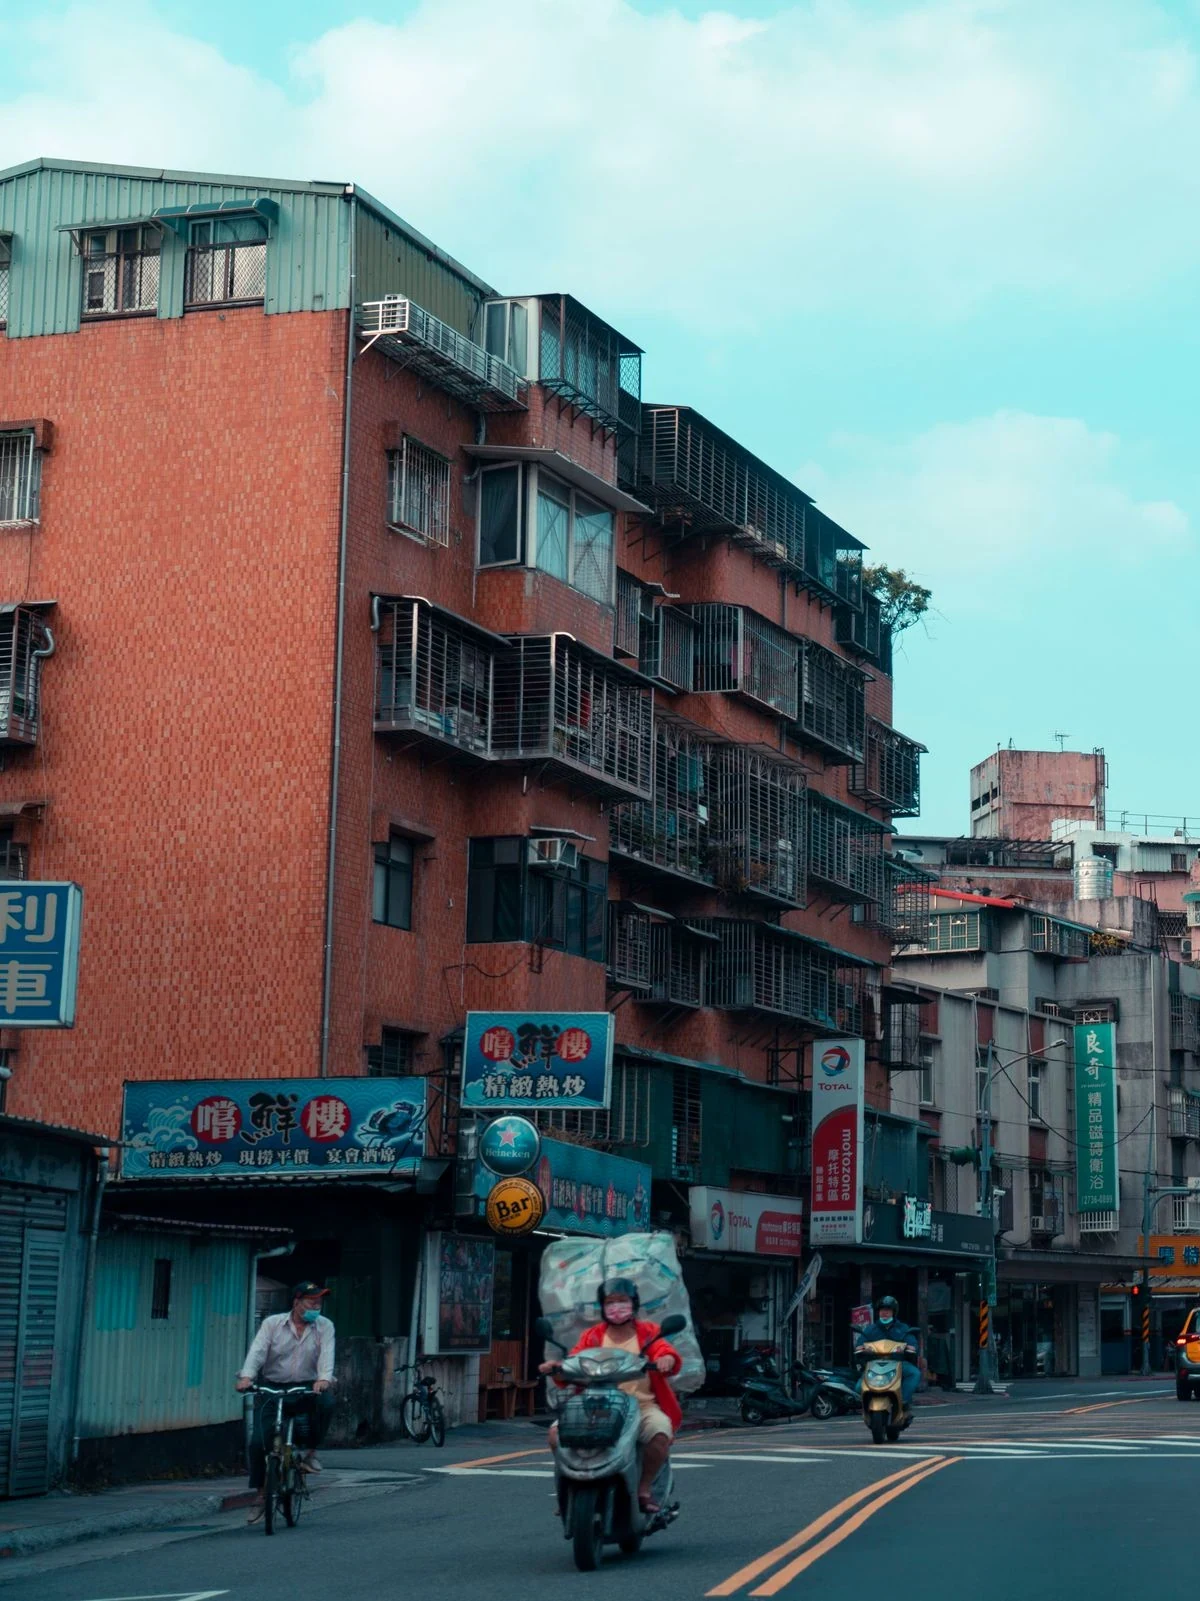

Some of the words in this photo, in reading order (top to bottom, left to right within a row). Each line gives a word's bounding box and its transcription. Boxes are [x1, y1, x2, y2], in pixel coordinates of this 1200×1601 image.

[483, 1023, 589, 1070] 嚐鮮樓
[1084, 1030, 1104, 1080] 良奇
[484, 1075, 586, 1097] 精緻熱炒
[818, 1083, 853, 1091] TOTAL
[196, 1092, 346, 1145] 嚐鮮樓
[150, 1151, 222, 1168] 精緻熱炒
[239, 1149, 309, 1165] 現撈平價
[326, 1147, 395, 1163] 宴會酒席
[485, 1148, 530, 1159] Heineken
[841, 1129, 852, 1201] motozone
[495, 1197, 529, 1219] Bar
[728, 1211, 752, 1228] TOTAL
